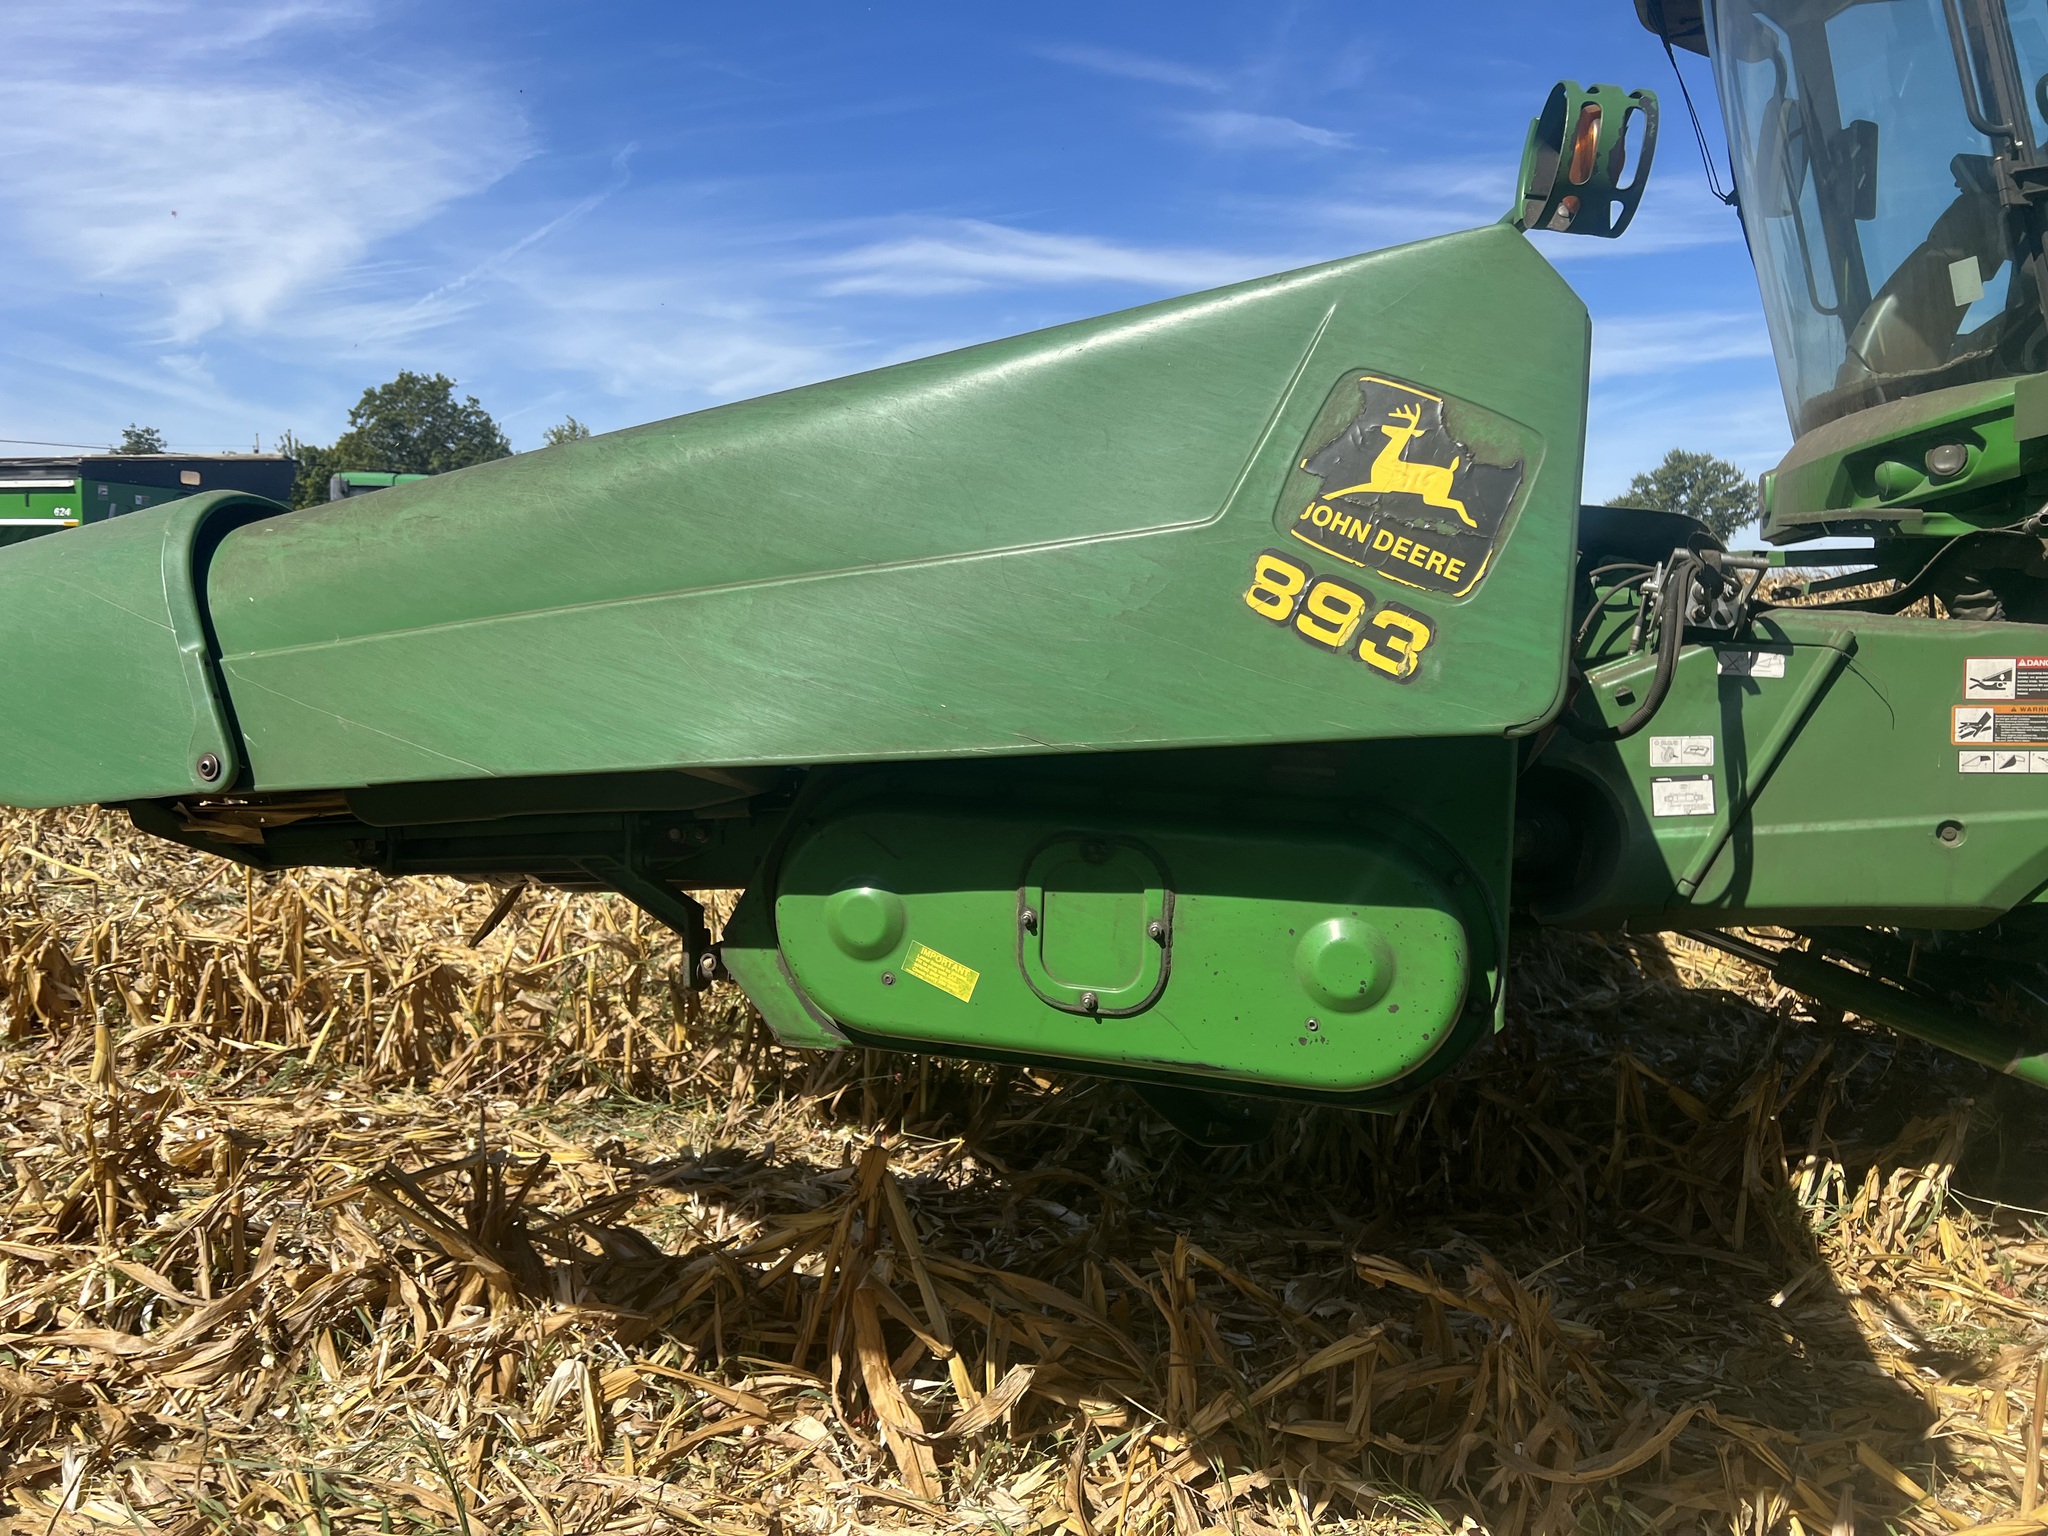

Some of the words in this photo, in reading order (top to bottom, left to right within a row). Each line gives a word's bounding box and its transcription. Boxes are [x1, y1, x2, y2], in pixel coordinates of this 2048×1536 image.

[53, 507, 71, 517] 624
[1300, 501, 1372, 544] JOHN
[1372, 530, 1467, 582] DEERE
[1245, 554, 1431, 678] 893
[920, 947, 971, 978] IMPORTANT
